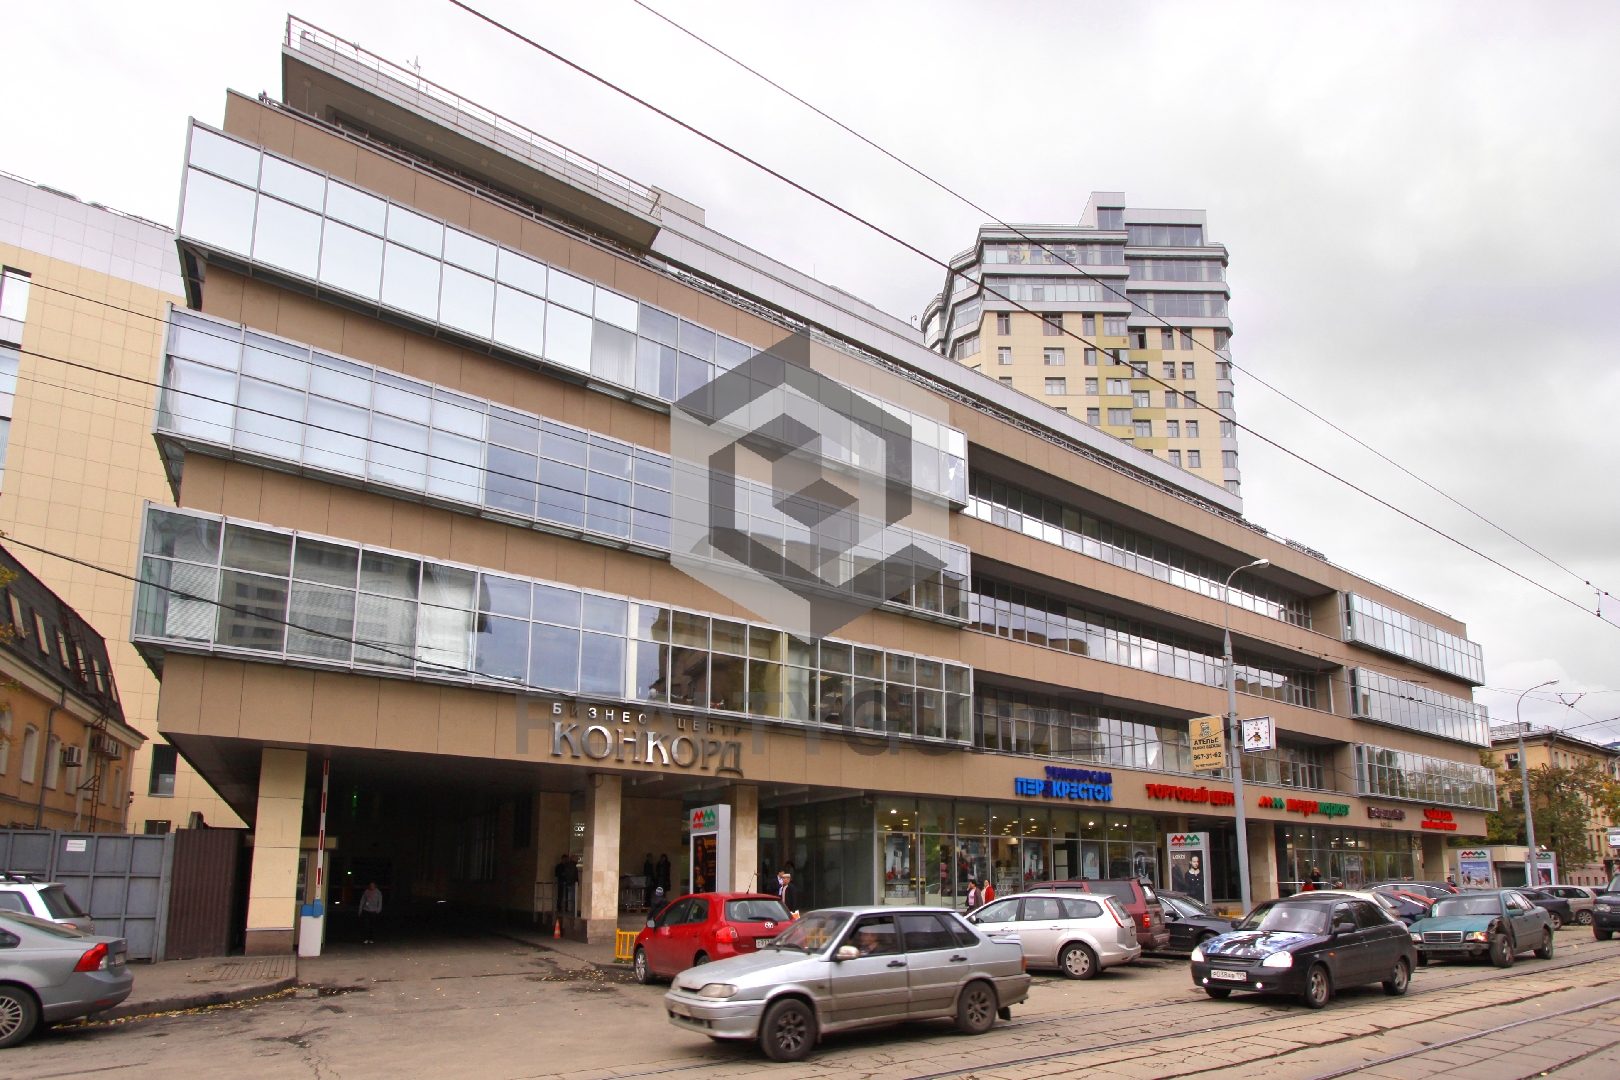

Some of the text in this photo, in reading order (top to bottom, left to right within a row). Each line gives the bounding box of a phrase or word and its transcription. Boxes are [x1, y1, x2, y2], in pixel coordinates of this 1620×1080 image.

[553, 703, 647, 724] БИЗНЕС
[552, 721, 744, 778] КОНКОРД
[1194, 737, 1218, 745] АТЕЛЬЕ
[1014, 777, 1113, 802] ПЕРЕКРЕСТОК
[1145, 783, 1244, 807] ТОРГОВЫЙ ЦЕН
